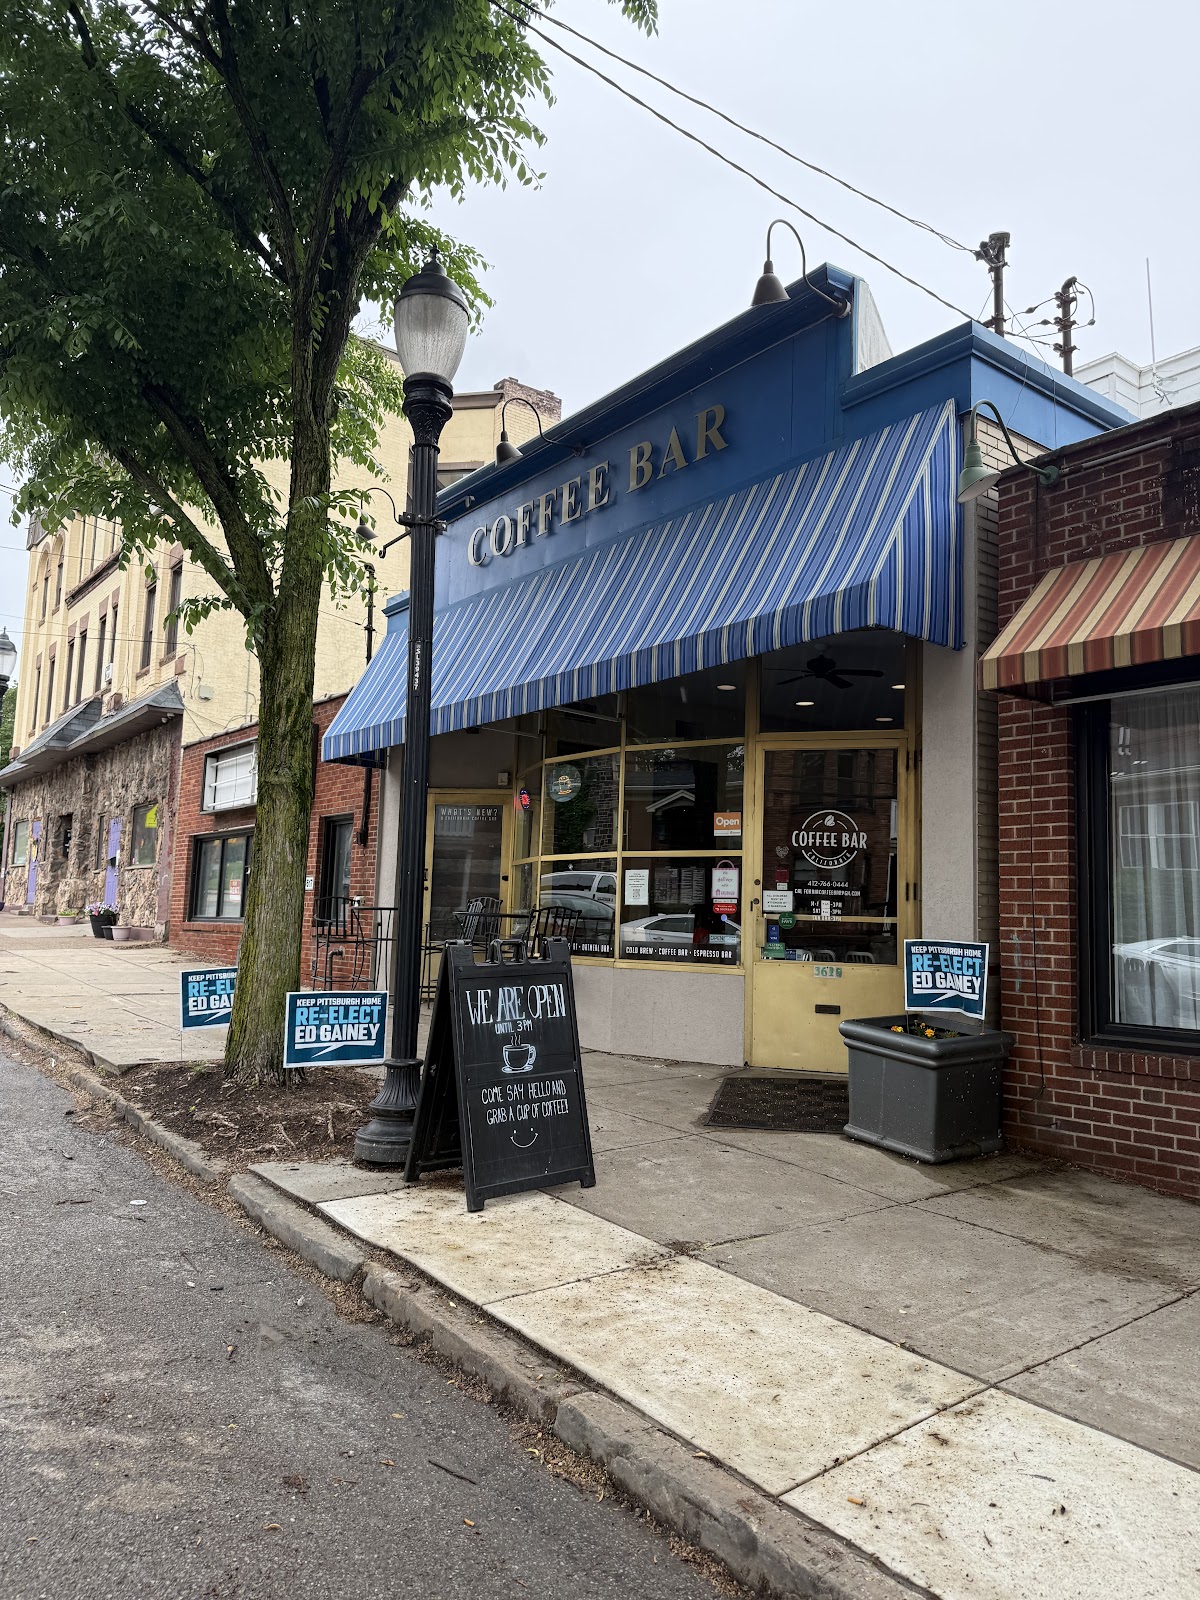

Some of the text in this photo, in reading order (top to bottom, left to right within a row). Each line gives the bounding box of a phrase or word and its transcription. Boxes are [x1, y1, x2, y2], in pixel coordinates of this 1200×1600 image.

[467, 404, 729, 567] COFFEE BAR
[476, 808, 498, 816] NEW?
[716, 816, 740, 828] Open
[791, 830, 868, 849] COFFEE BAR
[807, 880, 849, 888] 412-766-0444
[626, 946, 733, 959] COLD BREW COFFEE BAR ESPRESSO BAR
[910, 946, 927, 954] KEEP
[964, 949, 982, 958] HOME
[911, 954, 983, 977] RE-ELECT
[188, 974, 205, 982] KEEP
[912, 972, 933, 988] ED
[188, 996, 208, 1011] ED
[296, 997, 382, 1006] KEEP PITTSBURGH HOME
[465, 984, 566, 1025] WE ARE OPEN
[295, 1005, 382, 1026] RE-ELECT
[294, 1023, 381, 1043] ED GAINEY
[494, 1021, 514, 1034] UNTIL
[481, 1079, 566, 1105] COME SAY HELLO AND
[486, 1098, 569, 1125] GRAB A CUP OF COFFEE!
